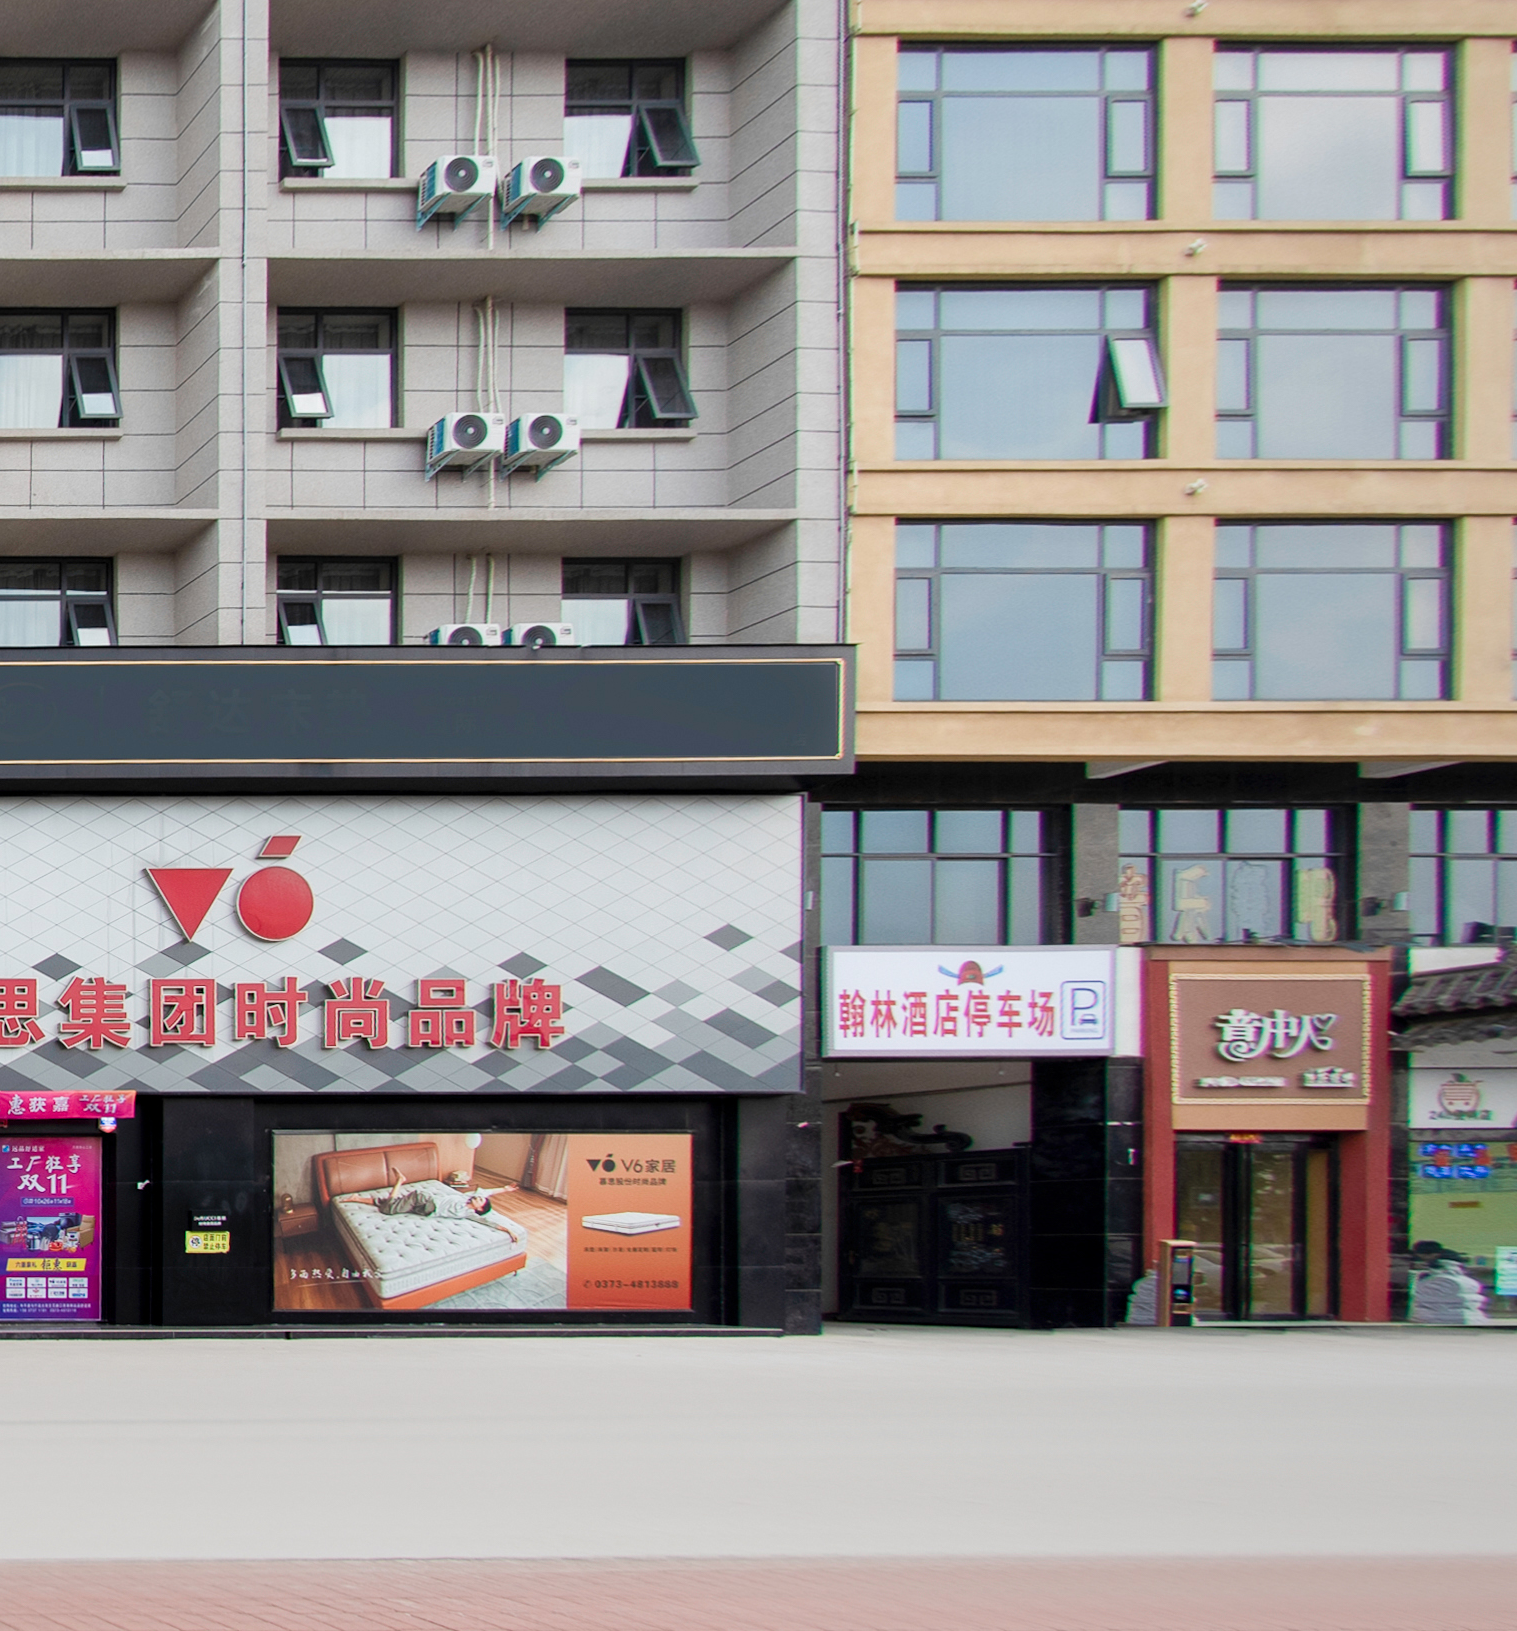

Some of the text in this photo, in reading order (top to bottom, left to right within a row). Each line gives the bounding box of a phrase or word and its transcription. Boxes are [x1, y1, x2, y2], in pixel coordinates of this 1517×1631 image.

[838, 989, 1056, 1039] 翰林酒店停车场
[1070, 987, 1099, 1027] P
[1215, 1008, 1339, 1062] 意中人
[83, 1102, 116, 1114] 双11
[7, 1154, 81, 1173] 工厂狂享
[621, 1158, 677, 1173] V6家居
[17, 1173, 67, 1194] 双11
